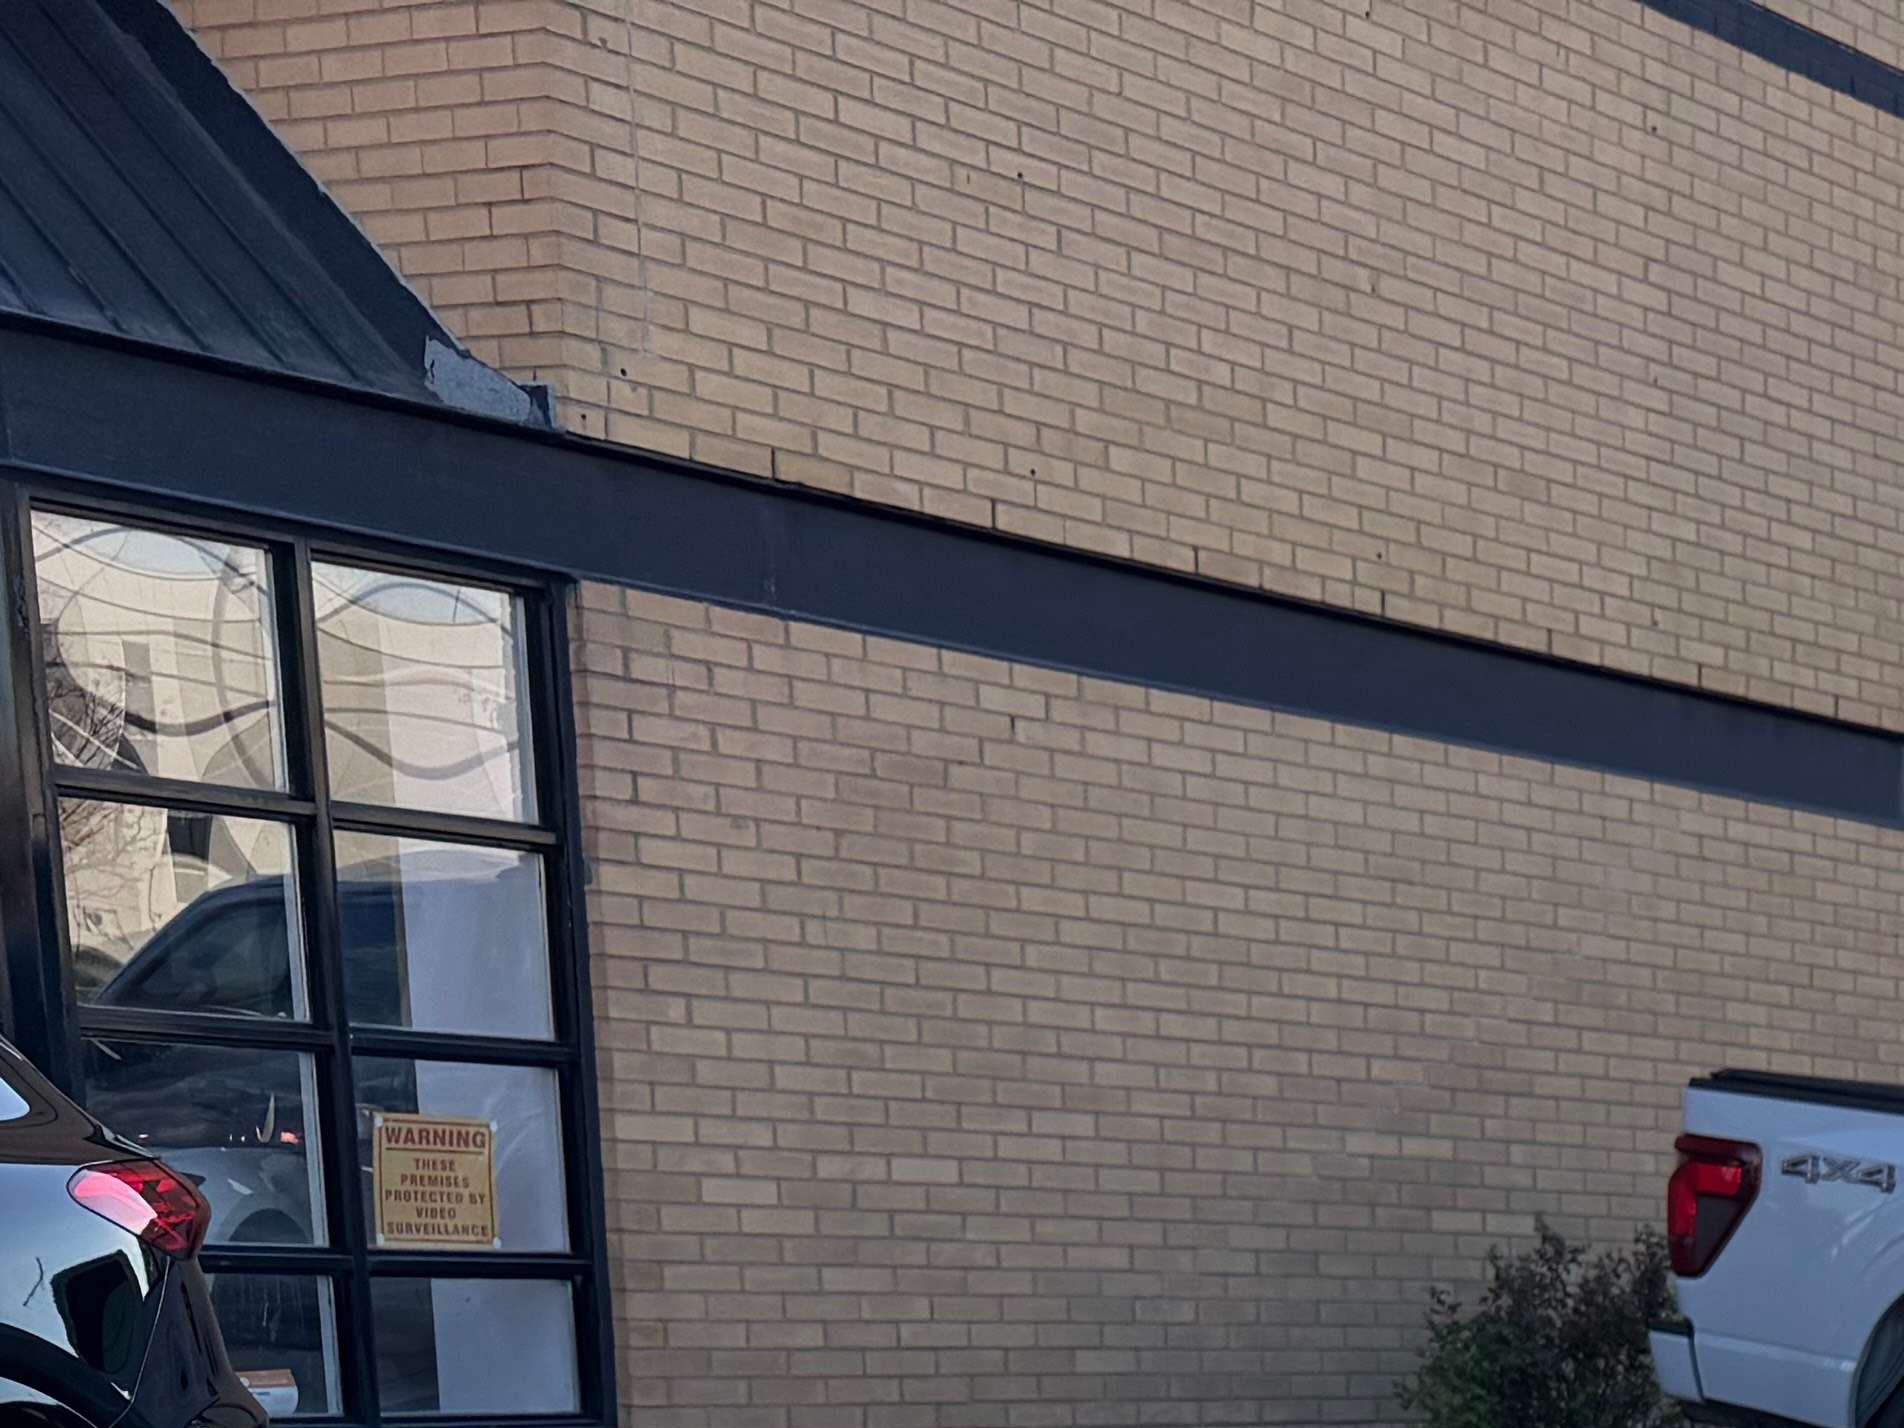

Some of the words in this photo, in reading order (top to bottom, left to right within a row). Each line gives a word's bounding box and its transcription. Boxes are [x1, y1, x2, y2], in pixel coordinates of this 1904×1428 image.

[384, 1126, 486, 1149] WARNING
[414, 1158, 456, 1172] THESE
[400, 1173, 470, 1189] PREMISES
[384, 1189, 464, 1204] PROTECTED
[468, 1192, 486, 1205] BY
[415, 1206, 457, 1220] VIDEO
[386, 1221, 489, 1237] SURVEILLANCE
